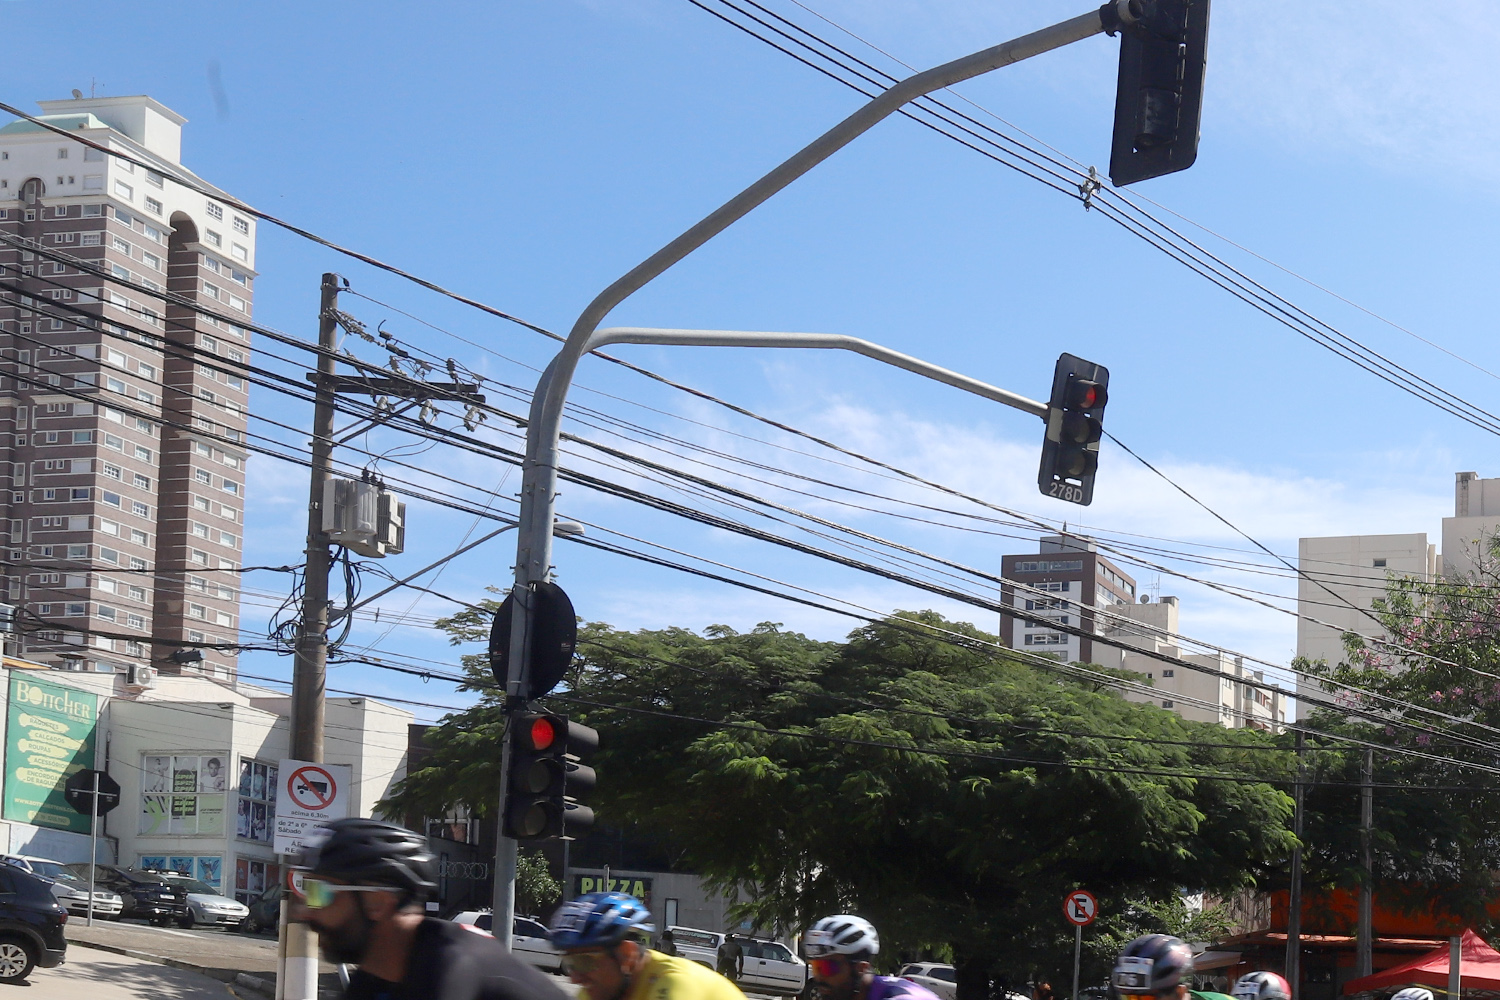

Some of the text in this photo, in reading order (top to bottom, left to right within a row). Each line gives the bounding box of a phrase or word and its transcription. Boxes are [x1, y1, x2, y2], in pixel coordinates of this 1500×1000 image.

[1049, 482, 1083, 502] 278D
[28, 743, 51, 756] ROUPAS
[581, 877, 645, 897] PIZZA
